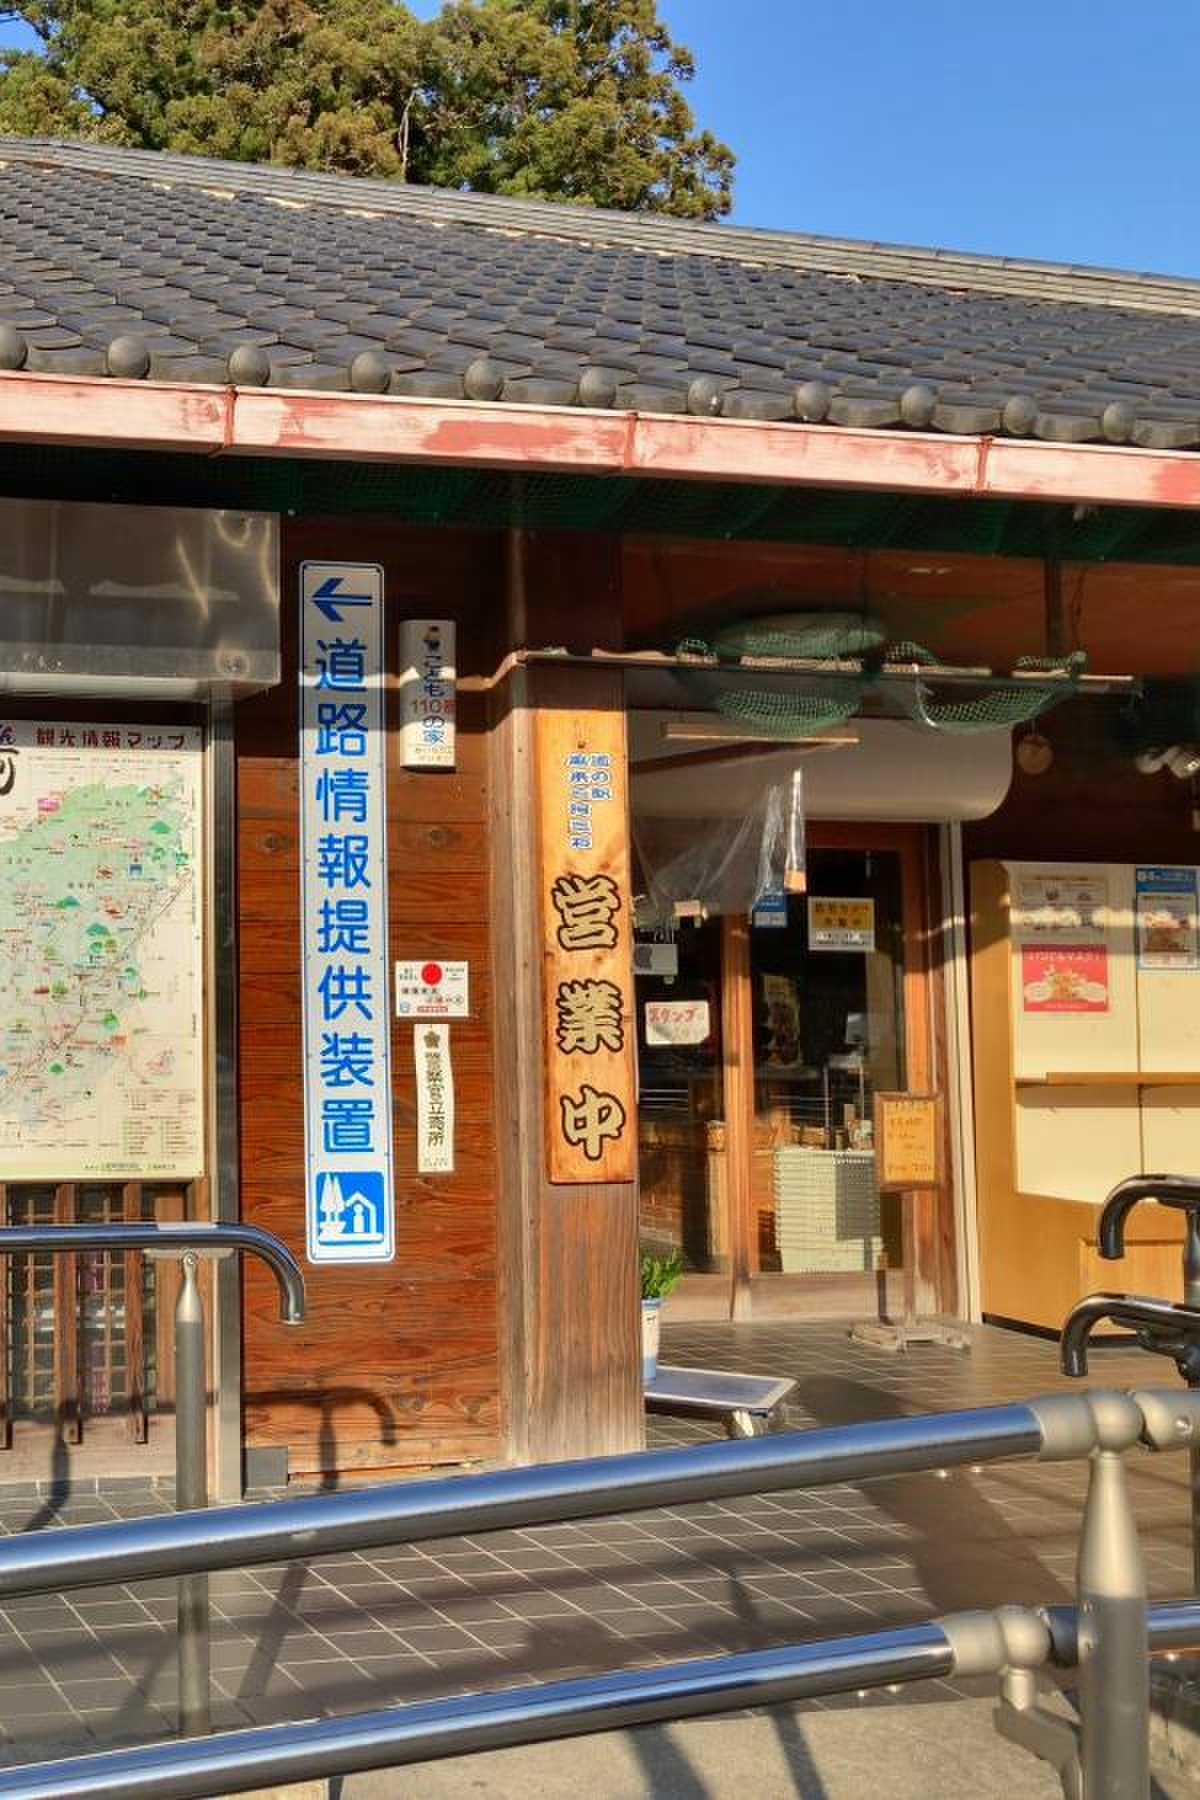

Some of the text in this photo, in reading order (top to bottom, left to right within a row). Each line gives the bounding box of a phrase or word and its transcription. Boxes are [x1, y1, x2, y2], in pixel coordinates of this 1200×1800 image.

[36, 727, 186, 749] 観光情報マップ
[315, 638, 375, 1153] 道路情報提供装置
[552, 874, 626, 1161] 営業中
